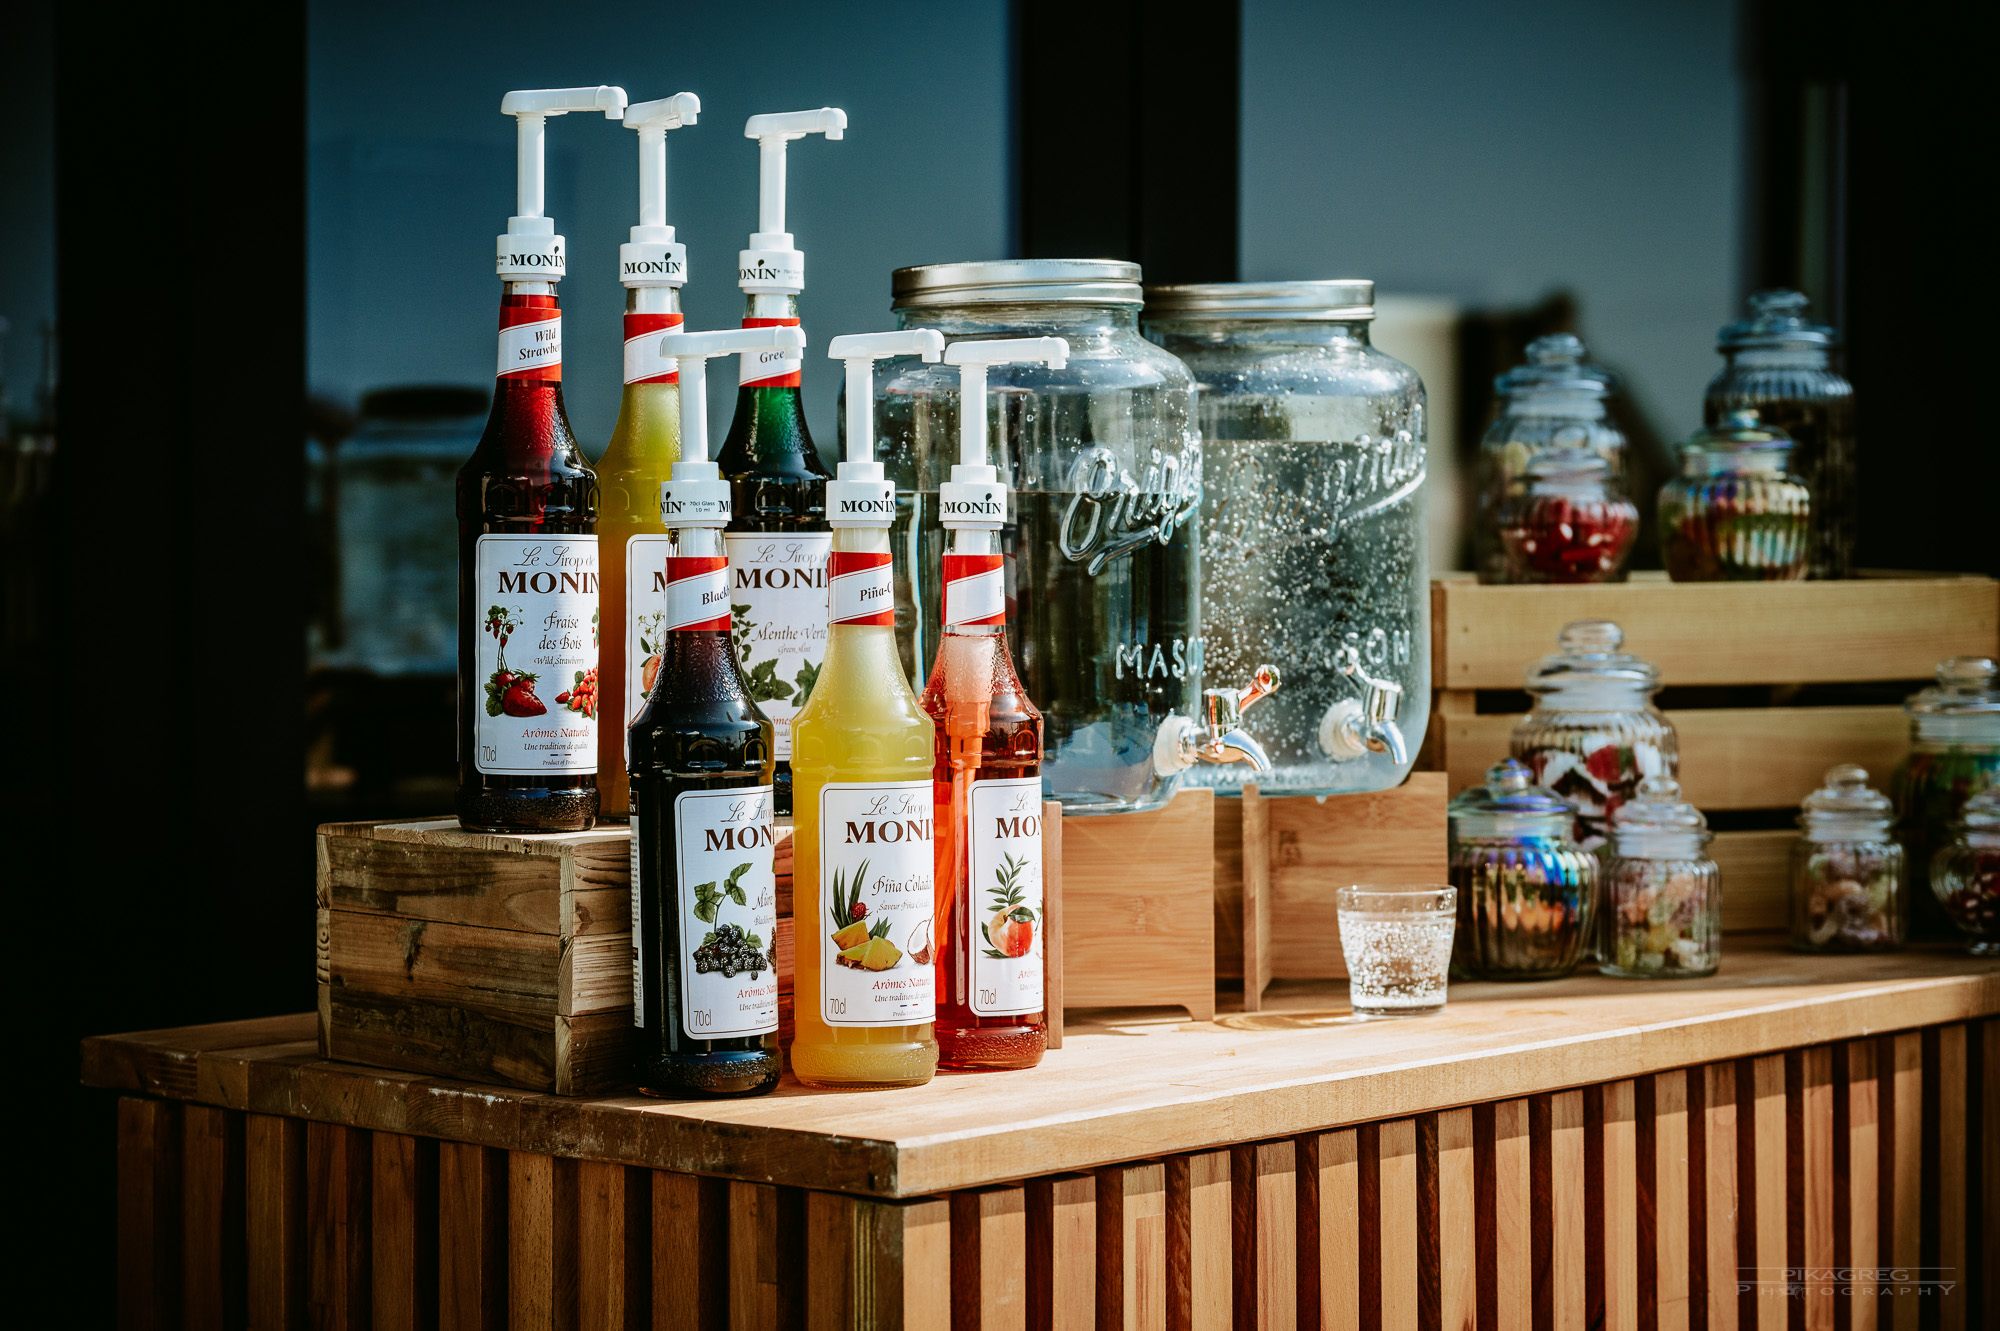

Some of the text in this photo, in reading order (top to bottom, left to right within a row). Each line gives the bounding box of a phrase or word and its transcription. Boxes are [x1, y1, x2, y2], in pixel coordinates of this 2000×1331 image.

[624, 252, 681, 274] MONIN
[739, 259, 777, 280] ONIN
[535, 328, 556, 343] Wild
[760, 350, 785, 363] Gree
[944, 493, 1001, 514] MONIN
[513, 546, 542, 566] Le
[545, 545, 584, 571] Sirop
[749, 544, 776, 563] Le
[779, 543, 817, 567] Sirop
[544, 610, 579, 631] Fraise
[751, 622, 827, 641] Menthe Verte
[538, 632, 581, 650] des Bois
[533, 655, 584, 667] Wild Strawberry
[1115, 636, 1204, 680] MASO
[521, 726, 590, 738] Arômes Naturels
[482, 745, 497, 762] 70cl
[524, 743, 539, 751] Une
[539, 742, 566, 750] tradition
[720, 800, 746, 822] Le
[861, 795, 890, 816] Le
[892, 793, 926, 818] Sirop
[704, 823, 775, 852] MON
[871, 875, 902, 896] Piña
[877, 900, 900, 913] Saveur
[737, 986, 766, 998] Arômes
[872, 979, 907, 990] Arômes
[979, 988, 997, 1005] 70cl
[830, 997, 847, 1015] 70cl
[693, 1009, 712, 1026] 70cl
